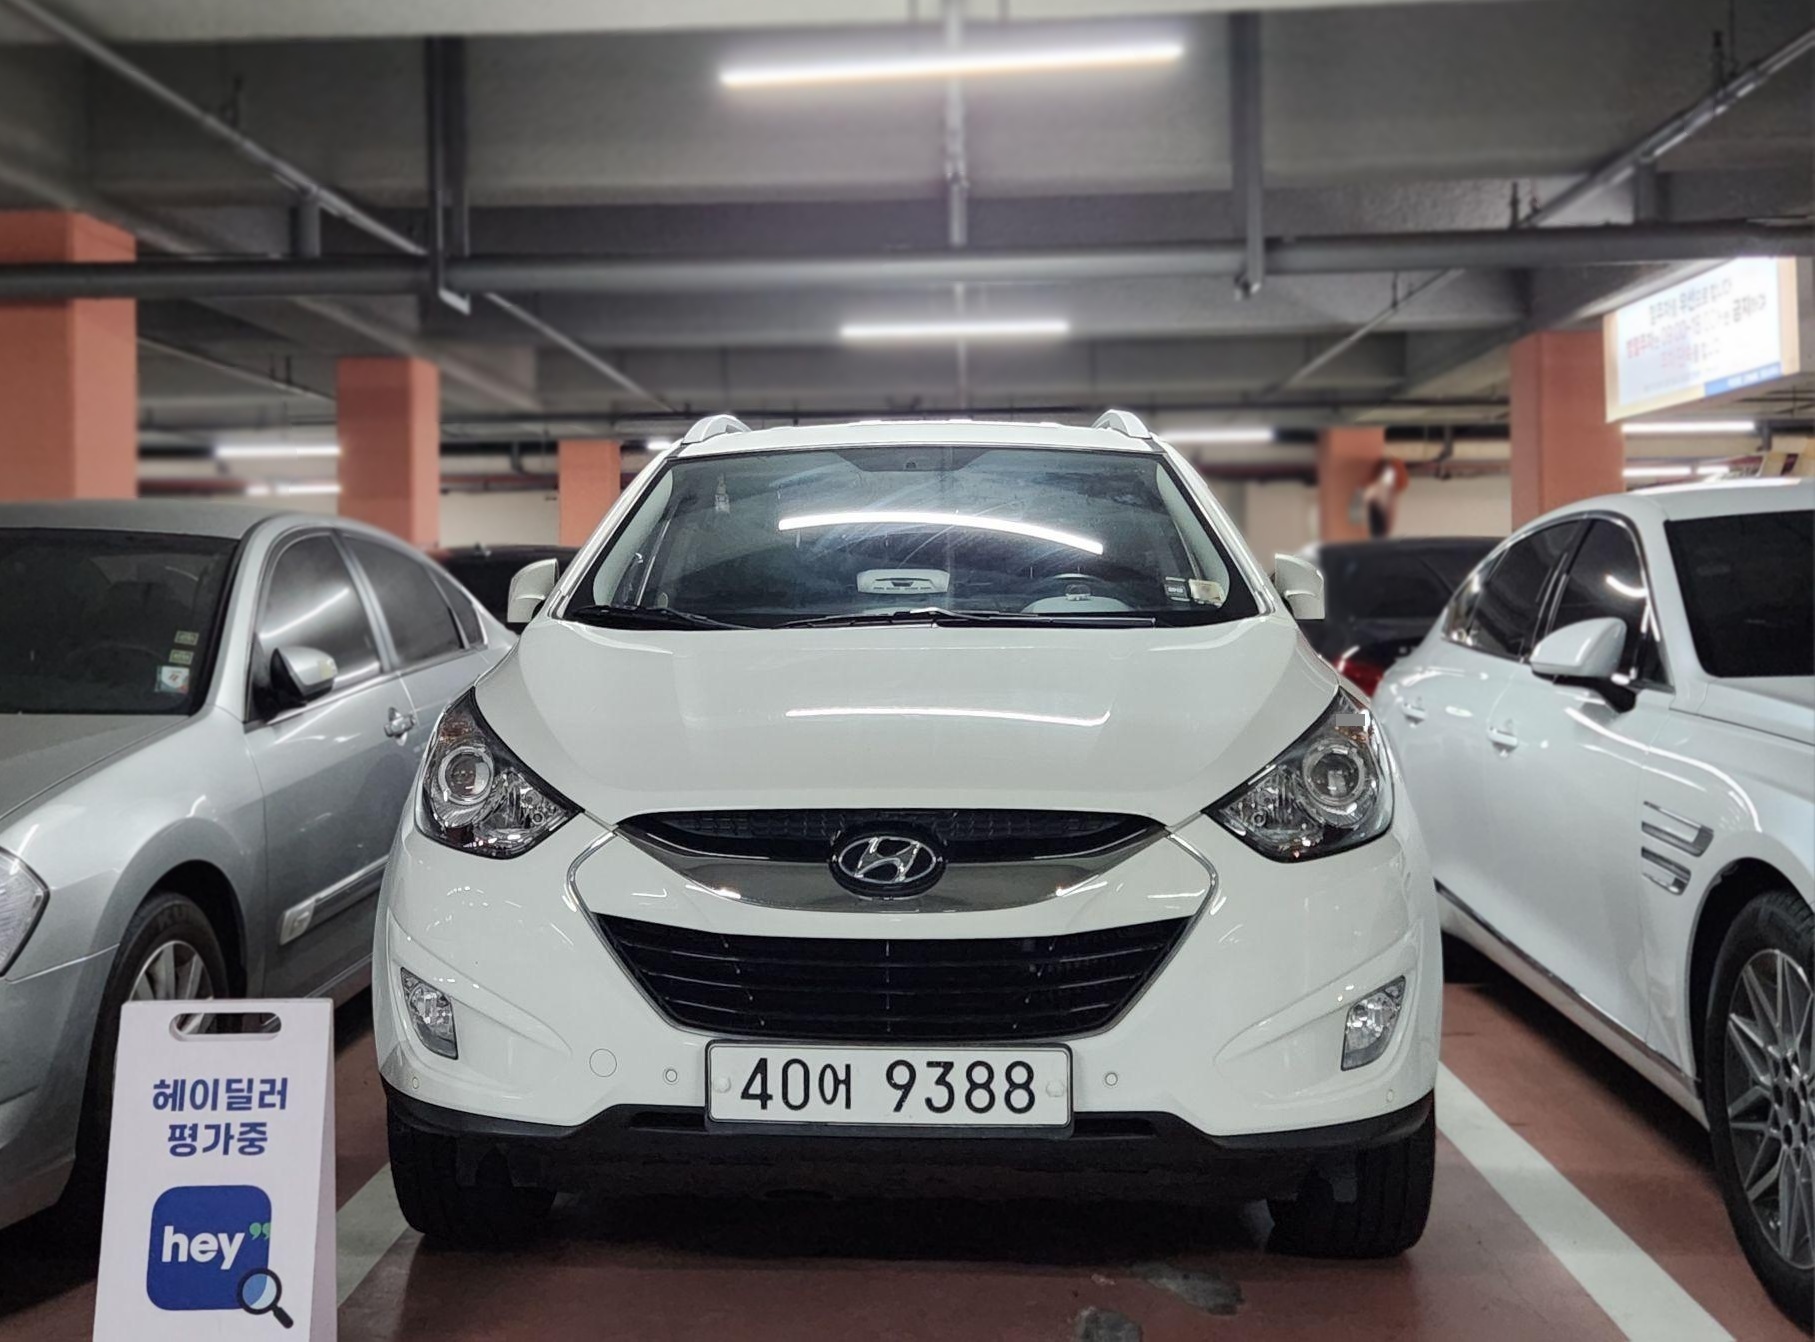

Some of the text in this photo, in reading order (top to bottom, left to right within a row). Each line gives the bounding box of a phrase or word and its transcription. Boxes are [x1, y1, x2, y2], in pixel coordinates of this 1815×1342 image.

[153, 1077, 288, 1112] 헤이딜러
[740, 1057, 1036, 1114] 40어 9388
[168, 1121, 268, 1158] 평가중
